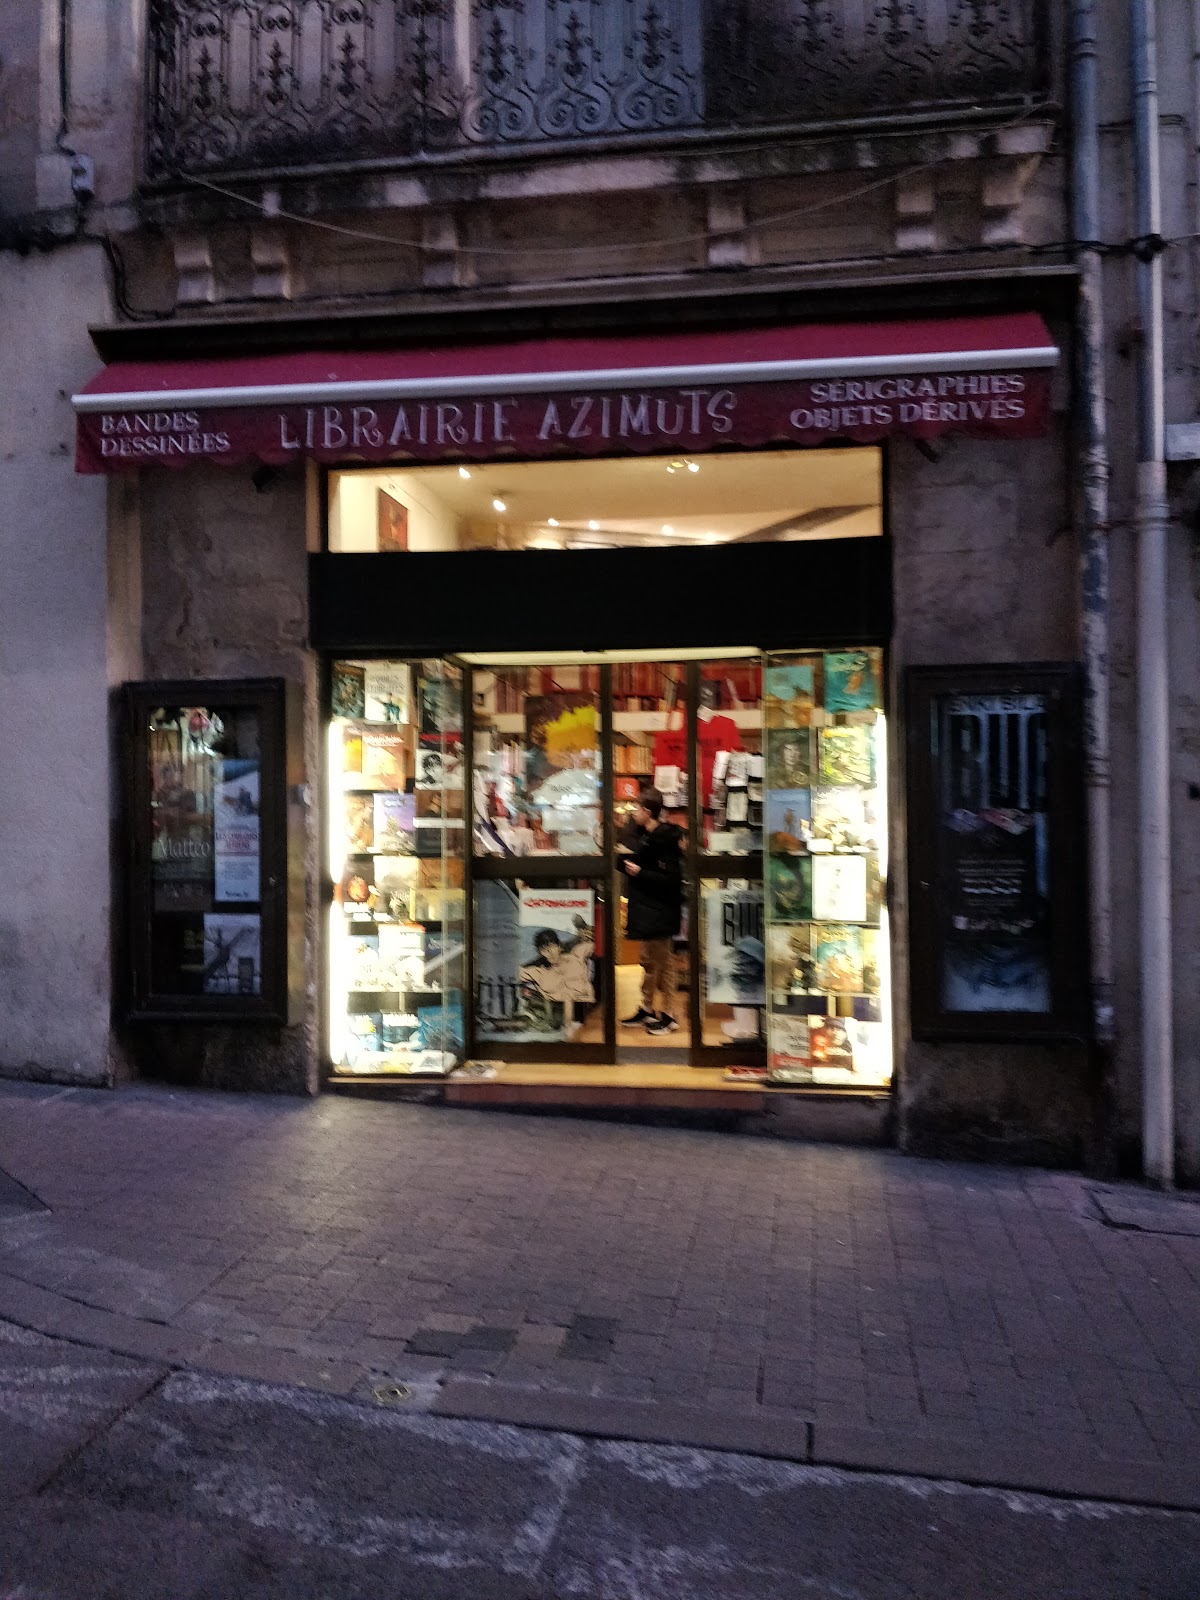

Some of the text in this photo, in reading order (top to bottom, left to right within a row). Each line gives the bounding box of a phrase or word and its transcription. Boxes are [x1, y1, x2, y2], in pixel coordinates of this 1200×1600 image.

[810, 374, 1026, 403] SÉRIGRAPHIES
[100, 409, 200, 434] BANDES
[279, 389, 738, 449] LIBRAIRIE AZIMUTS
[789, 396, 1026, 431] OBJETS DÉRIVÉS
[99, 429, 231, 458] DESSINÉES
